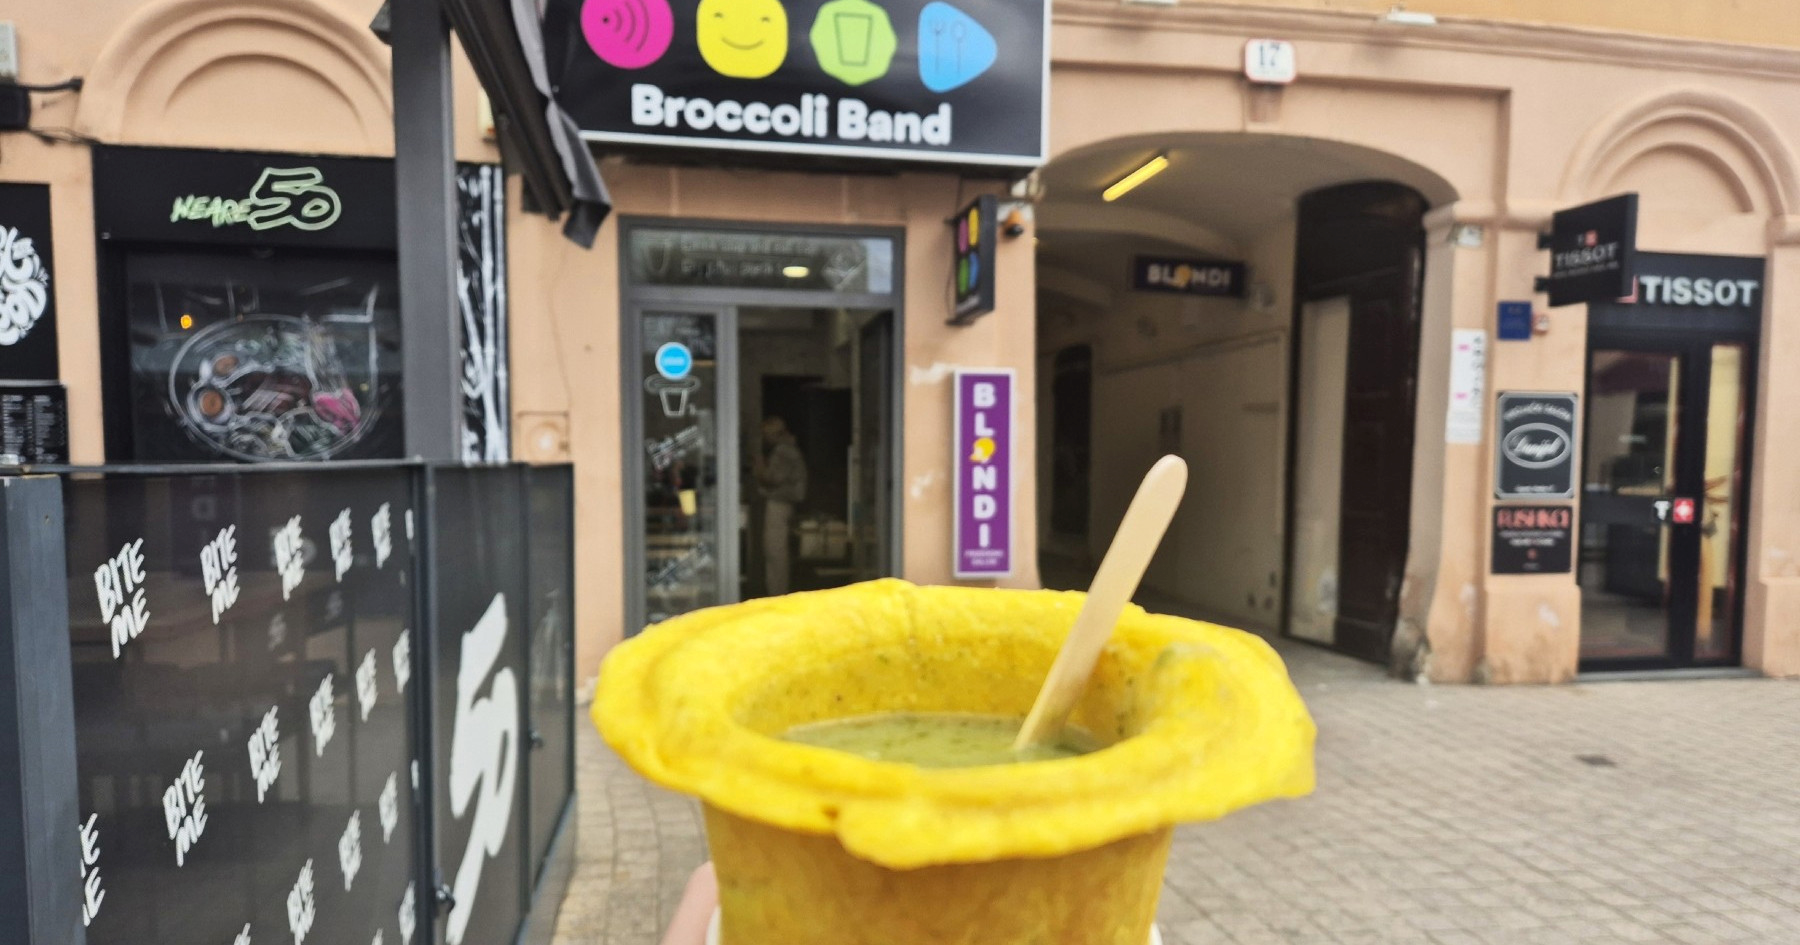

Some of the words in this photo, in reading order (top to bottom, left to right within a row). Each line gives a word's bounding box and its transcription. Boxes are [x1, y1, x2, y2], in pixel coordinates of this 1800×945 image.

[1259, 43, 1281, 67] 17
[631, 83, 829, 138] Broccoli
[837, 98, 952, 146] Band
[1555, 241, 1619, 267] TISSOT
[1639, 275, 1759, 307] TISSOT
[94, 537, 147, 625] BITE
[200, 523, 238, 597] BITE
[111, 588, 150, 659] ME
[212, 566, 241, 626] ME
[163, 750, 206, 841] BITE
[176, 794, 209, 868] ME
